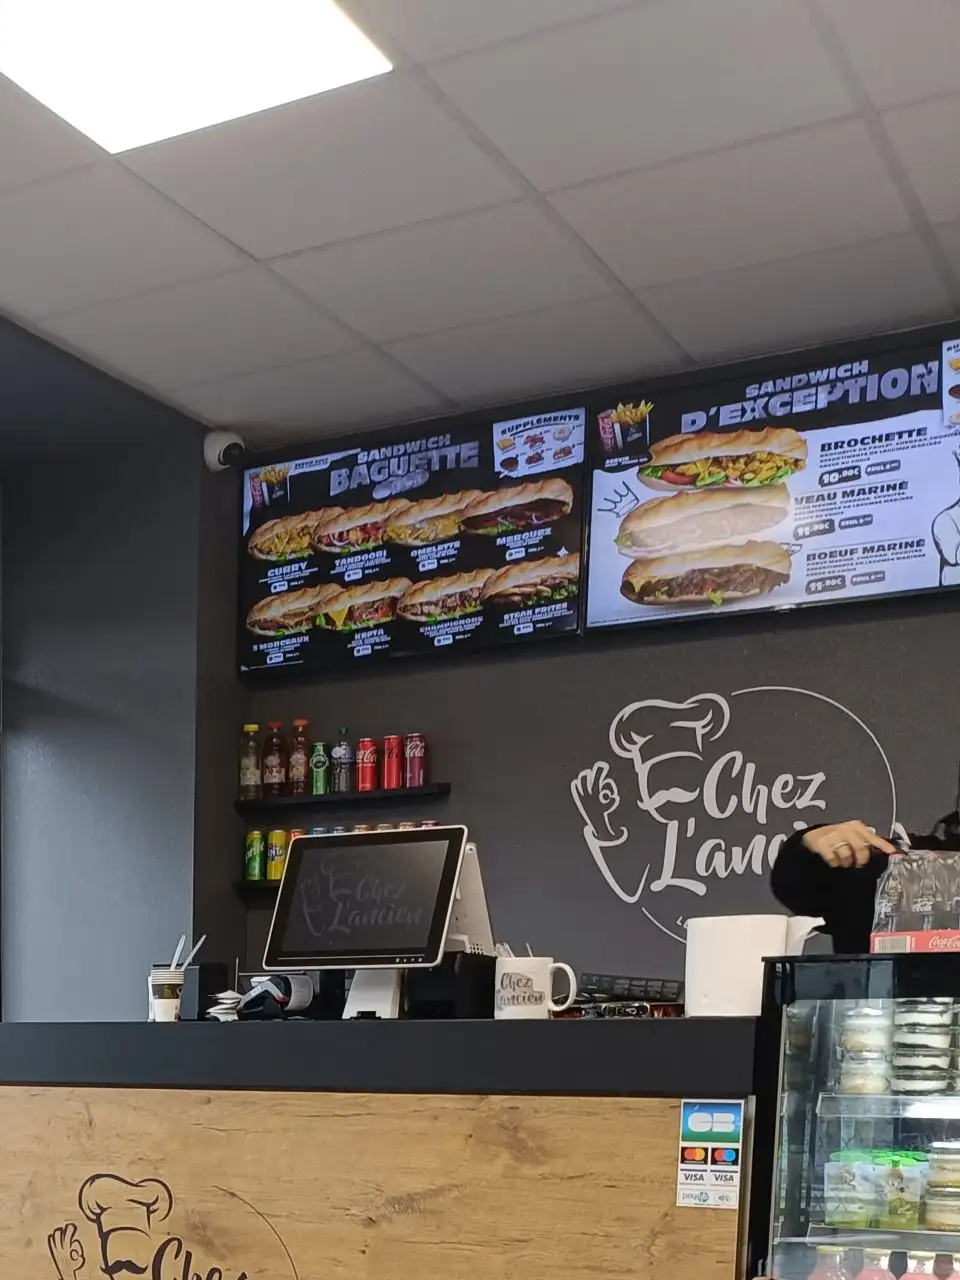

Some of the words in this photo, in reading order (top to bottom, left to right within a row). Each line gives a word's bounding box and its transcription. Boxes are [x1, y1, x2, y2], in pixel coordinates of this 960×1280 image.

[745, 359, 869, 398] SANDWICH
[681, 360, 939, 433] D'EXCEPTION
[357, 433, 451, 464] SANDWICH
[820, 427, 927, 453] BROCHETTE
[330, 441, 479, 496] BAGUETTE
[794, 491, 837, 506] VEAU
[841, 480, 909, 499] MARINÉ
[806, 547, 859, 561] BOEUF
[862, 538, 926, 554] MARINÉ
[267, 561, 307, 577] CURRY
[703, 751, 826, 824] Chez
[650, 817, 808, 896] L'anc
[501, 972, 533, 991] Chez
[684, 1173, 704, 1181] VISA
[714, 1174, 734, 1182] VISA
